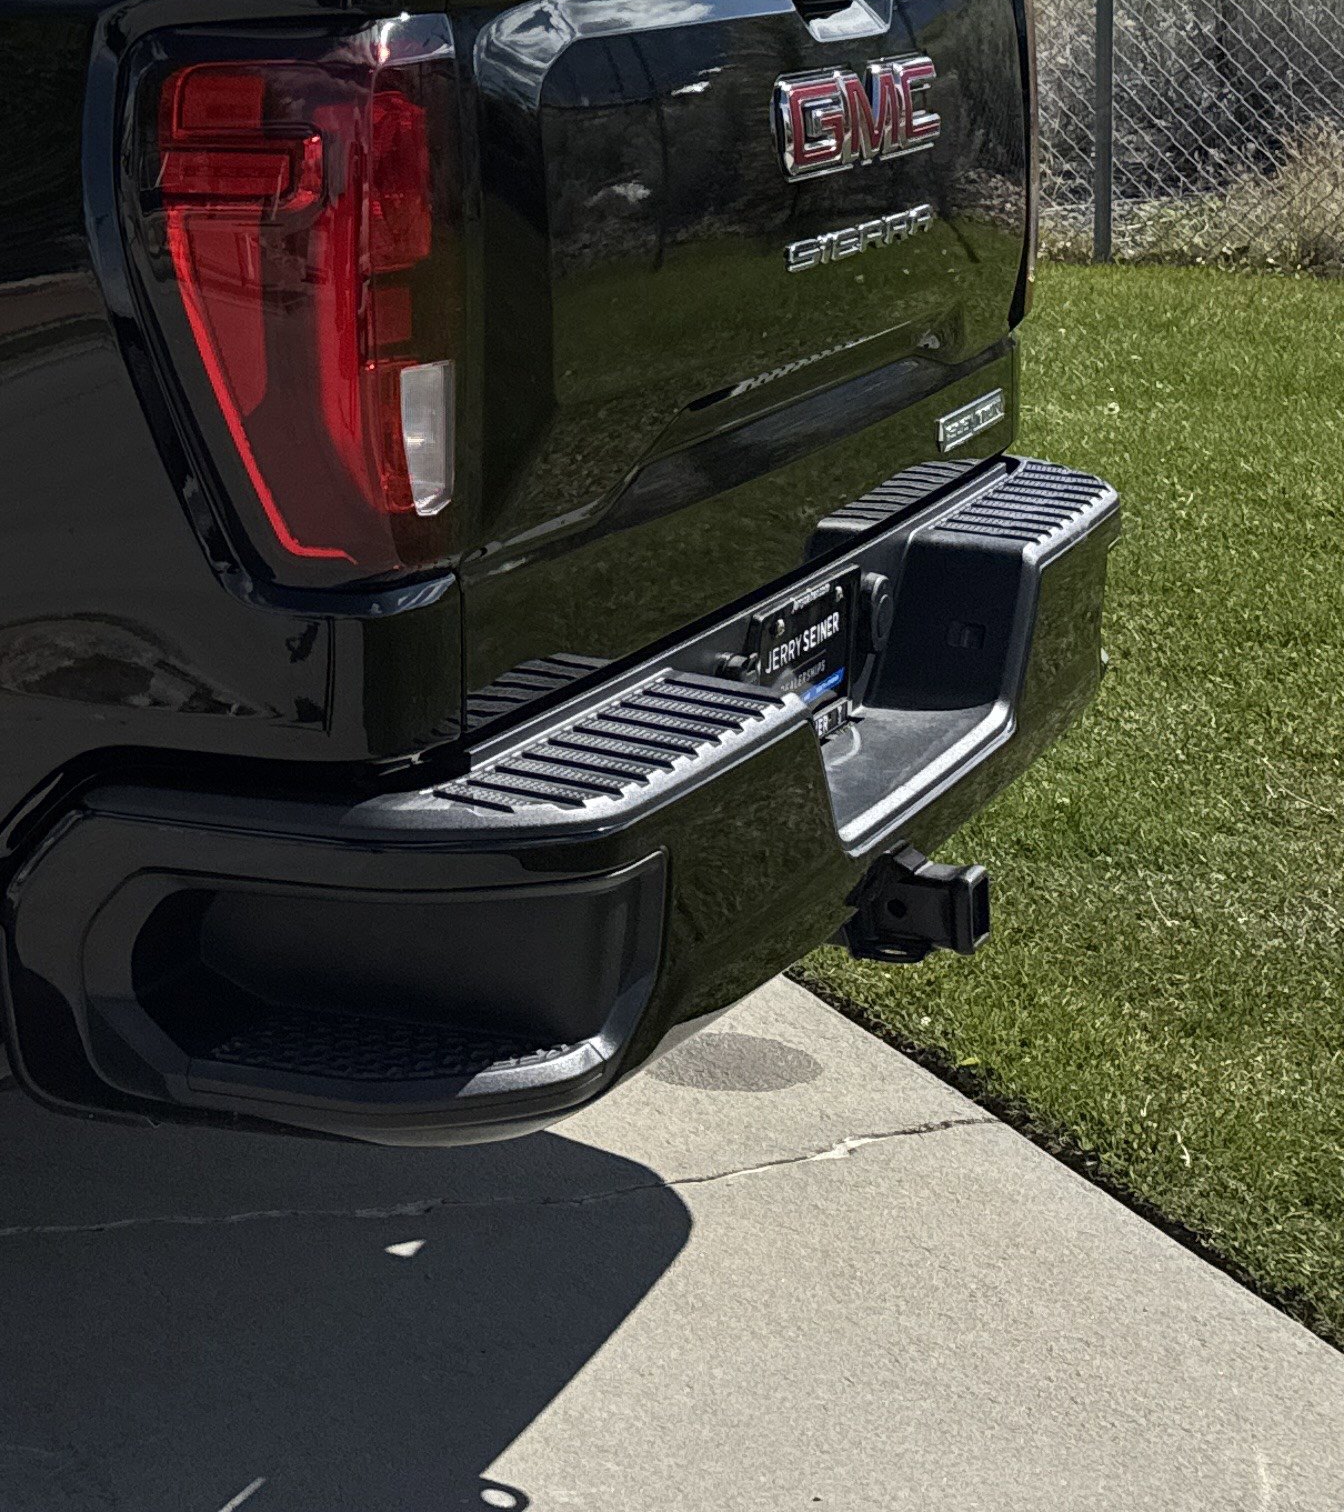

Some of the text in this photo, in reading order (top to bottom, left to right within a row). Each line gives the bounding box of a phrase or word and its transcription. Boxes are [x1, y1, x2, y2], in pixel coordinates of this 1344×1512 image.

[771, 53, 940, 183] GMC
[784, 204, 935, 273] SIERRA
[765, 611, 840, 674] JERRY SEINER
